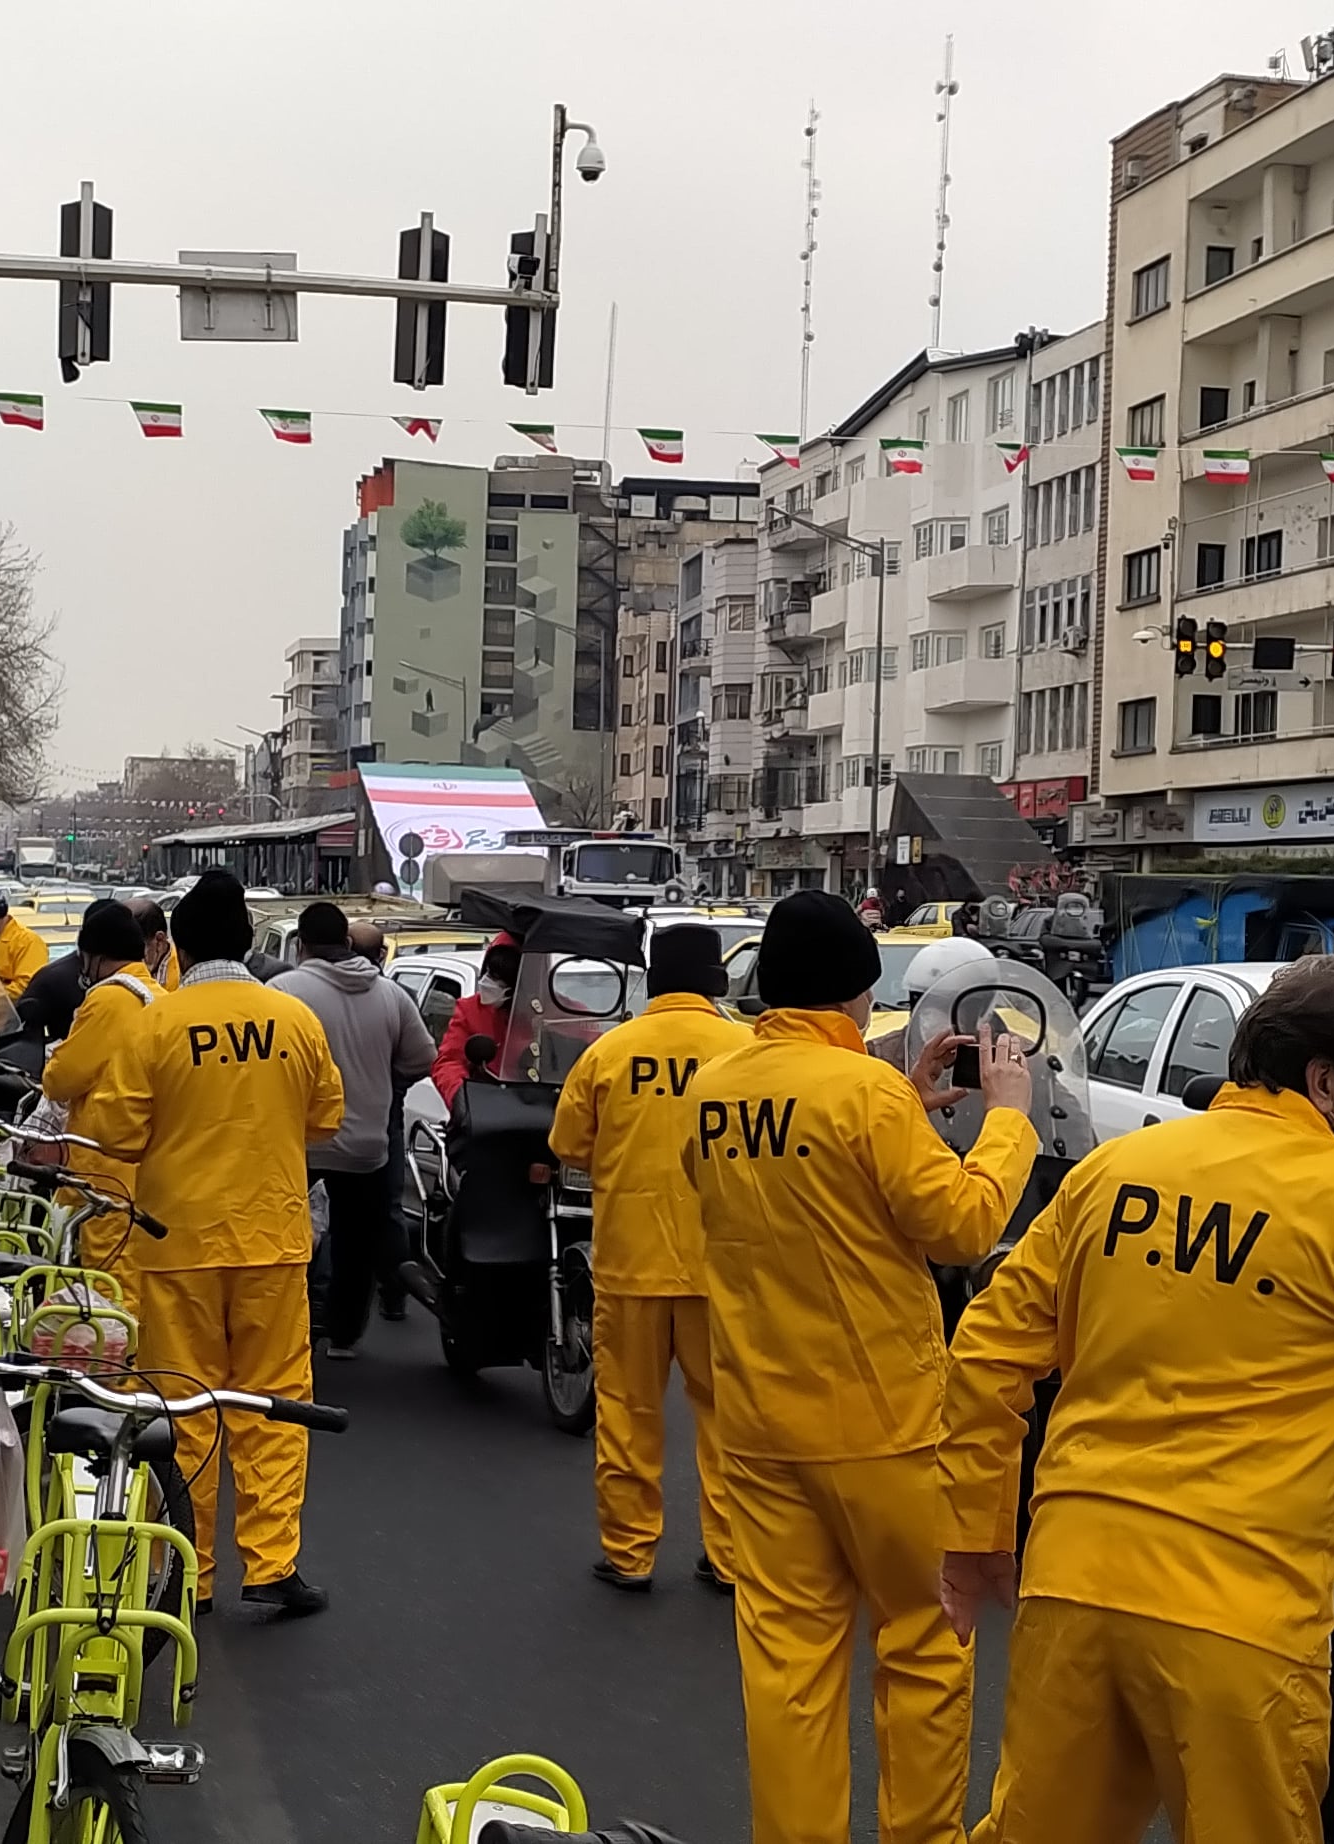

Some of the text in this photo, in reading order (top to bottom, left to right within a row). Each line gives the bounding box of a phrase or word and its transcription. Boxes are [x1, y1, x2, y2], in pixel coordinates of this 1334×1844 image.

[188, 1019, 288, 1067] P.W.
[699, 1097, 810, 1160] P.W.
[1103, 1183, 1276, 1296] P.W.
